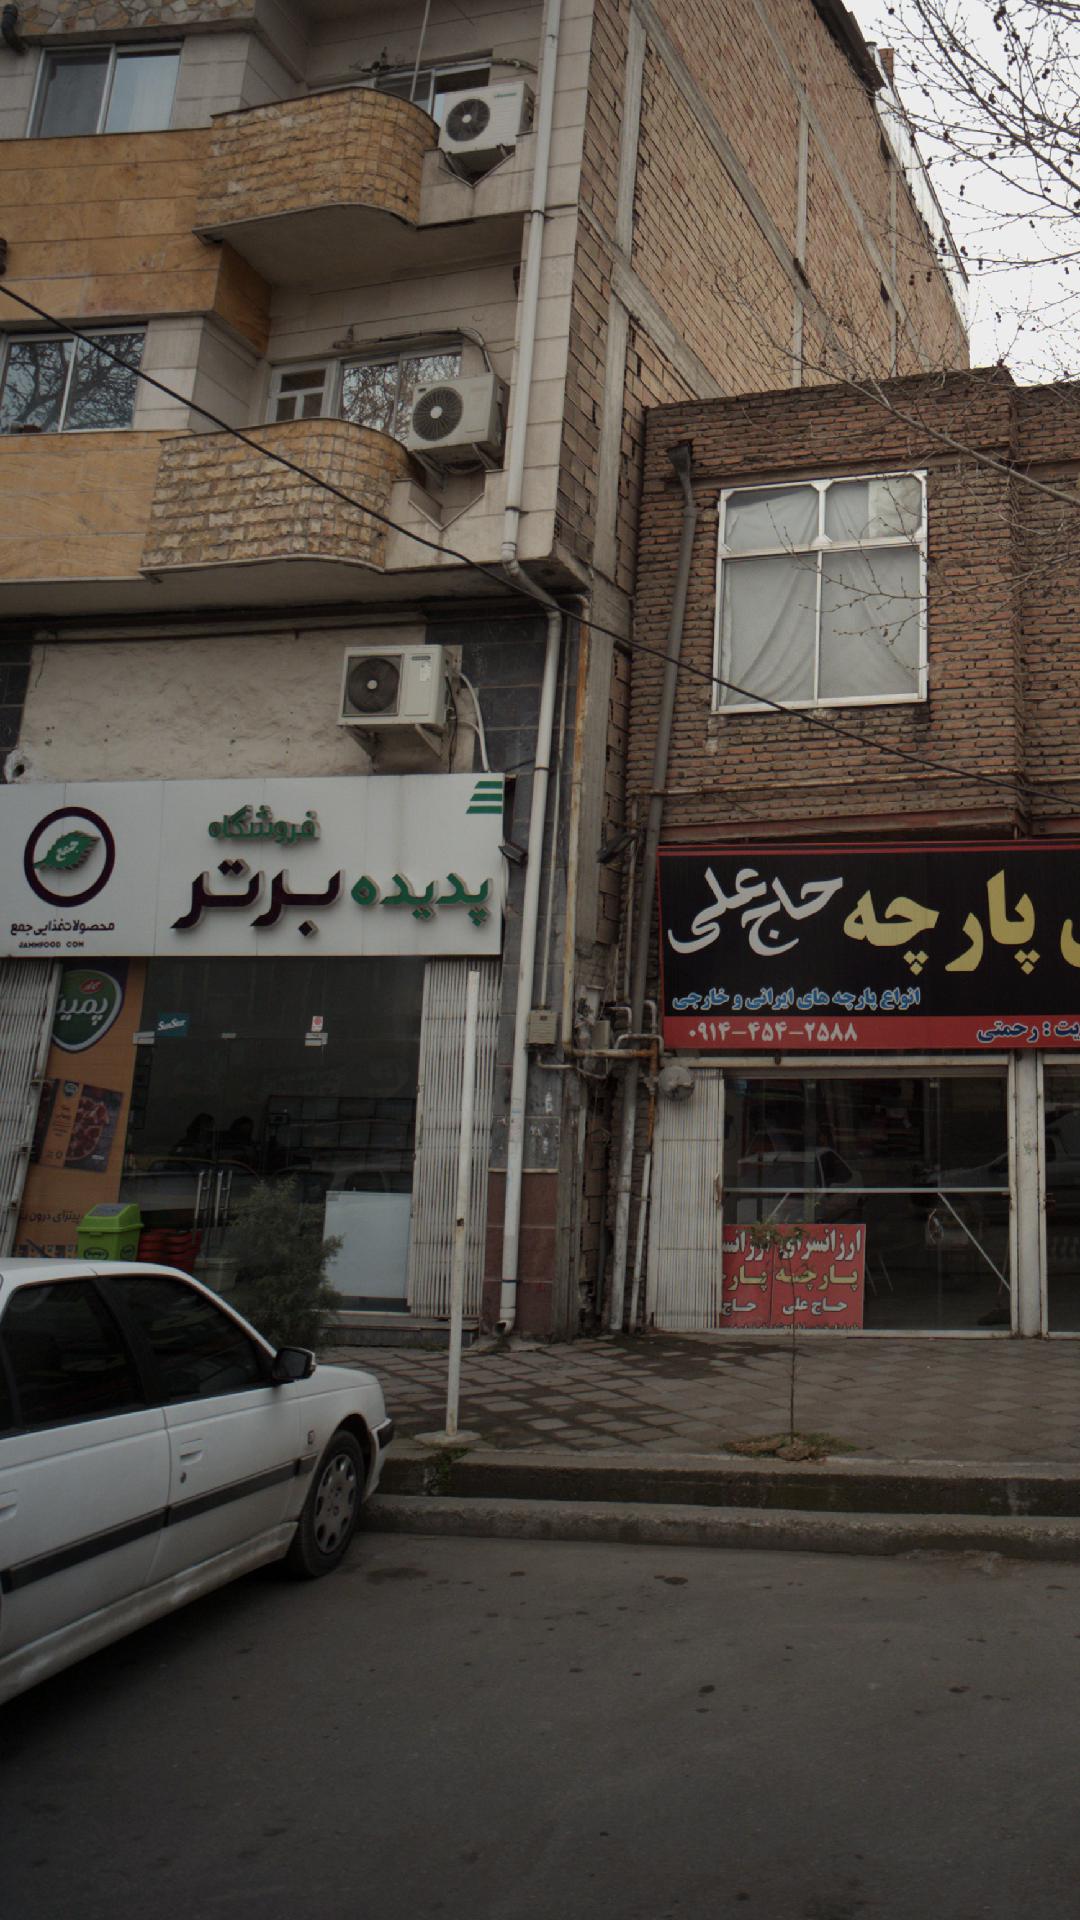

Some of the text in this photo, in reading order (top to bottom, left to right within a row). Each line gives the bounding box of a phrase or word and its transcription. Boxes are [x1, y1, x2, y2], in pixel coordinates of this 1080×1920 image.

[209, 805, 319, 844] فروشگاه
[171, 859, 492, 937] پدیده برتر
[667, 866, 768, 954] علی
[741, 876, 844, 957] حاج
[844, 869, 1041, 976] پارچه
[672, 986, 921, 1012] انواع پارچه های ایرانی و خارجی
[977, 1020, 1039, 1043] رحمتی
[775, 1264, 858, 1292] پارچه
[782, 1296, 848, 1315] حاج علی
